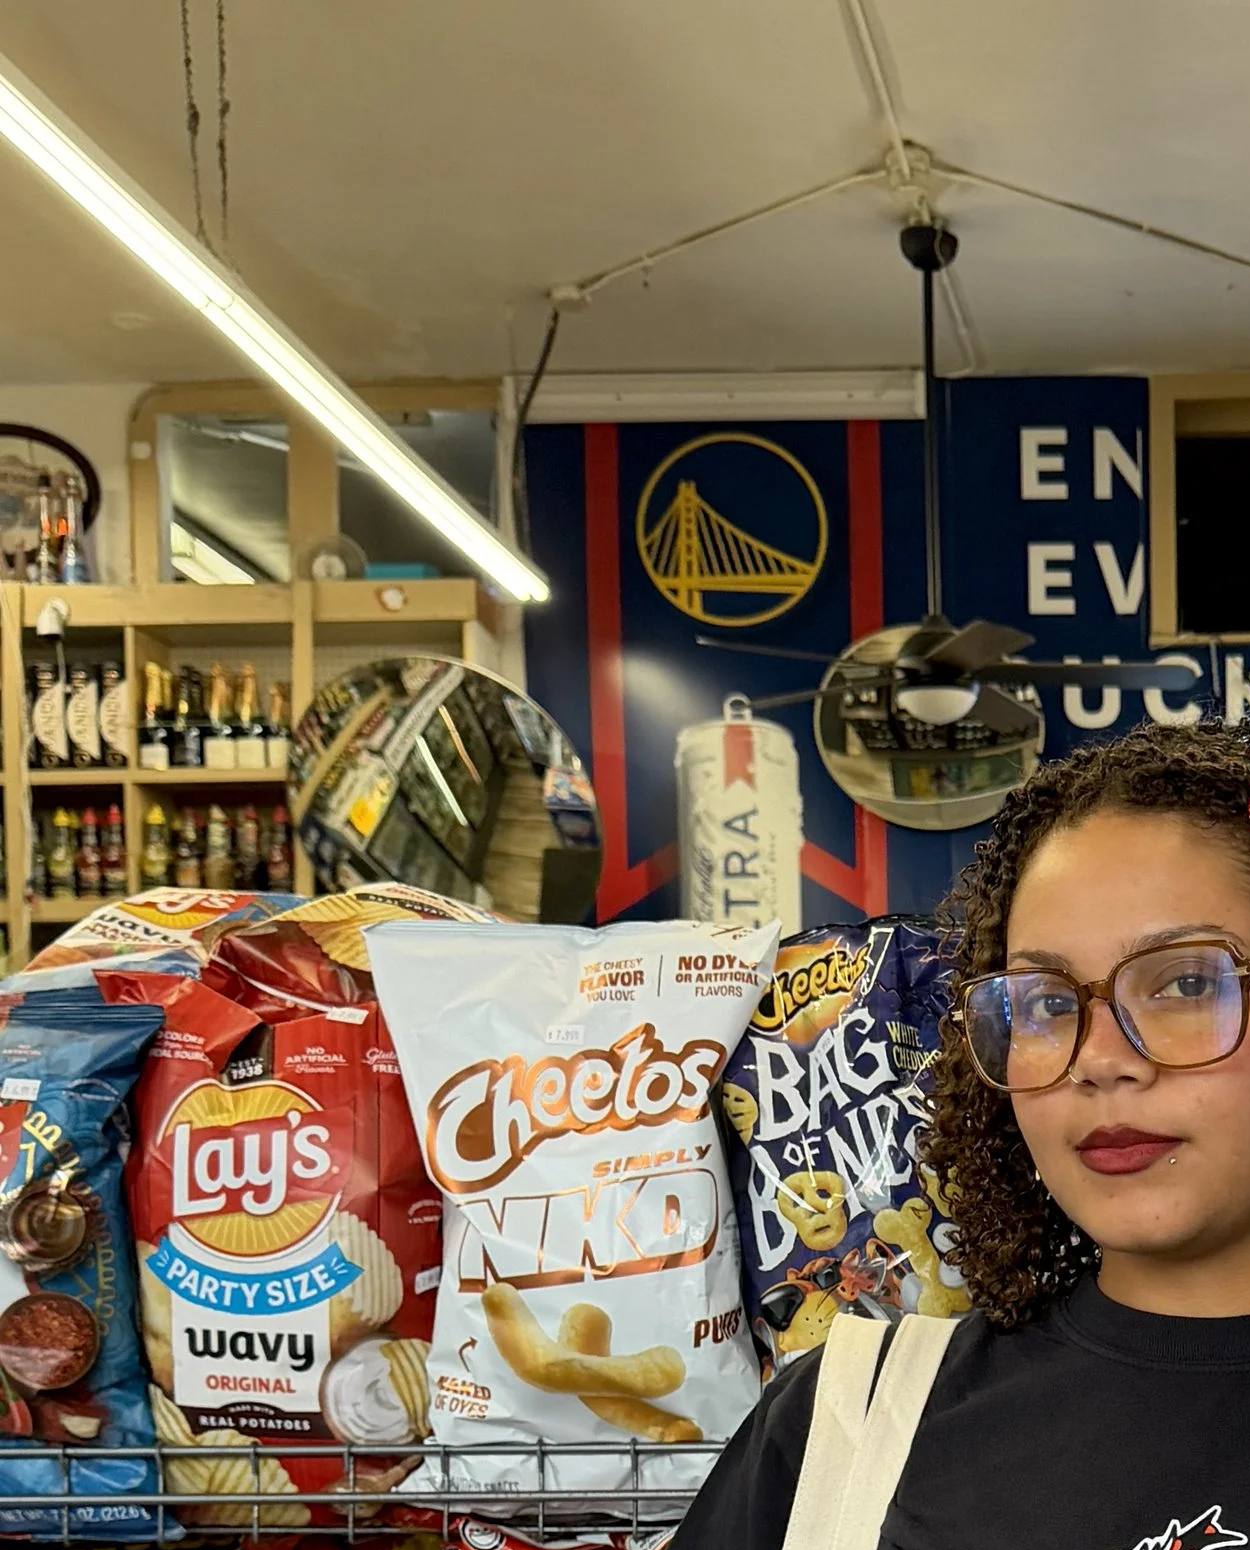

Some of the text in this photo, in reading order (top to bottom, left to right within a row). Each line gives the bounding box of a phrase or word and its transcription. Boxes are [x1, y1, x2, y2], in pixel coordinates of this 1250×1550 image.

[722, 802, 760, 928] TRA
[603, 958, 643, 971] CHEESY
[678, 955, 707, 971] NO
[579, 970, 645, 993] FLAVOR
[675, 973, 692, 984] OR
[609, 990, 636, 1002] LOVE
[695, 985, 743, 998] FLAVORS
[285, 1054, 346, 1064] ARTIFICIAL
[306, 1047, 325, 1055] NO
[231, 1063, 263, 1080] 1938
[750, 1006, 898, 1142] BAG
[432, 1030, 728, 1186] Cheetos
[173, 1107, 333, 1217] Lay's
[592, 1144, 713, 1178] SIMPLY
[782, 1135, 822, 1168] OF
[458, 1170, 718, 1292] NKD
[165, 1258, 337, 1310] PARTY SIZE
[693, 1308, 743, 1348] PUFFS
[185, 1325, 316, 1372] wavy
[206, 1374, 296, 1394] ORIGINAL
[450, 1394, 488, 1420] DYES
[200, 1415, 311, 1431] REAL POTATOES
